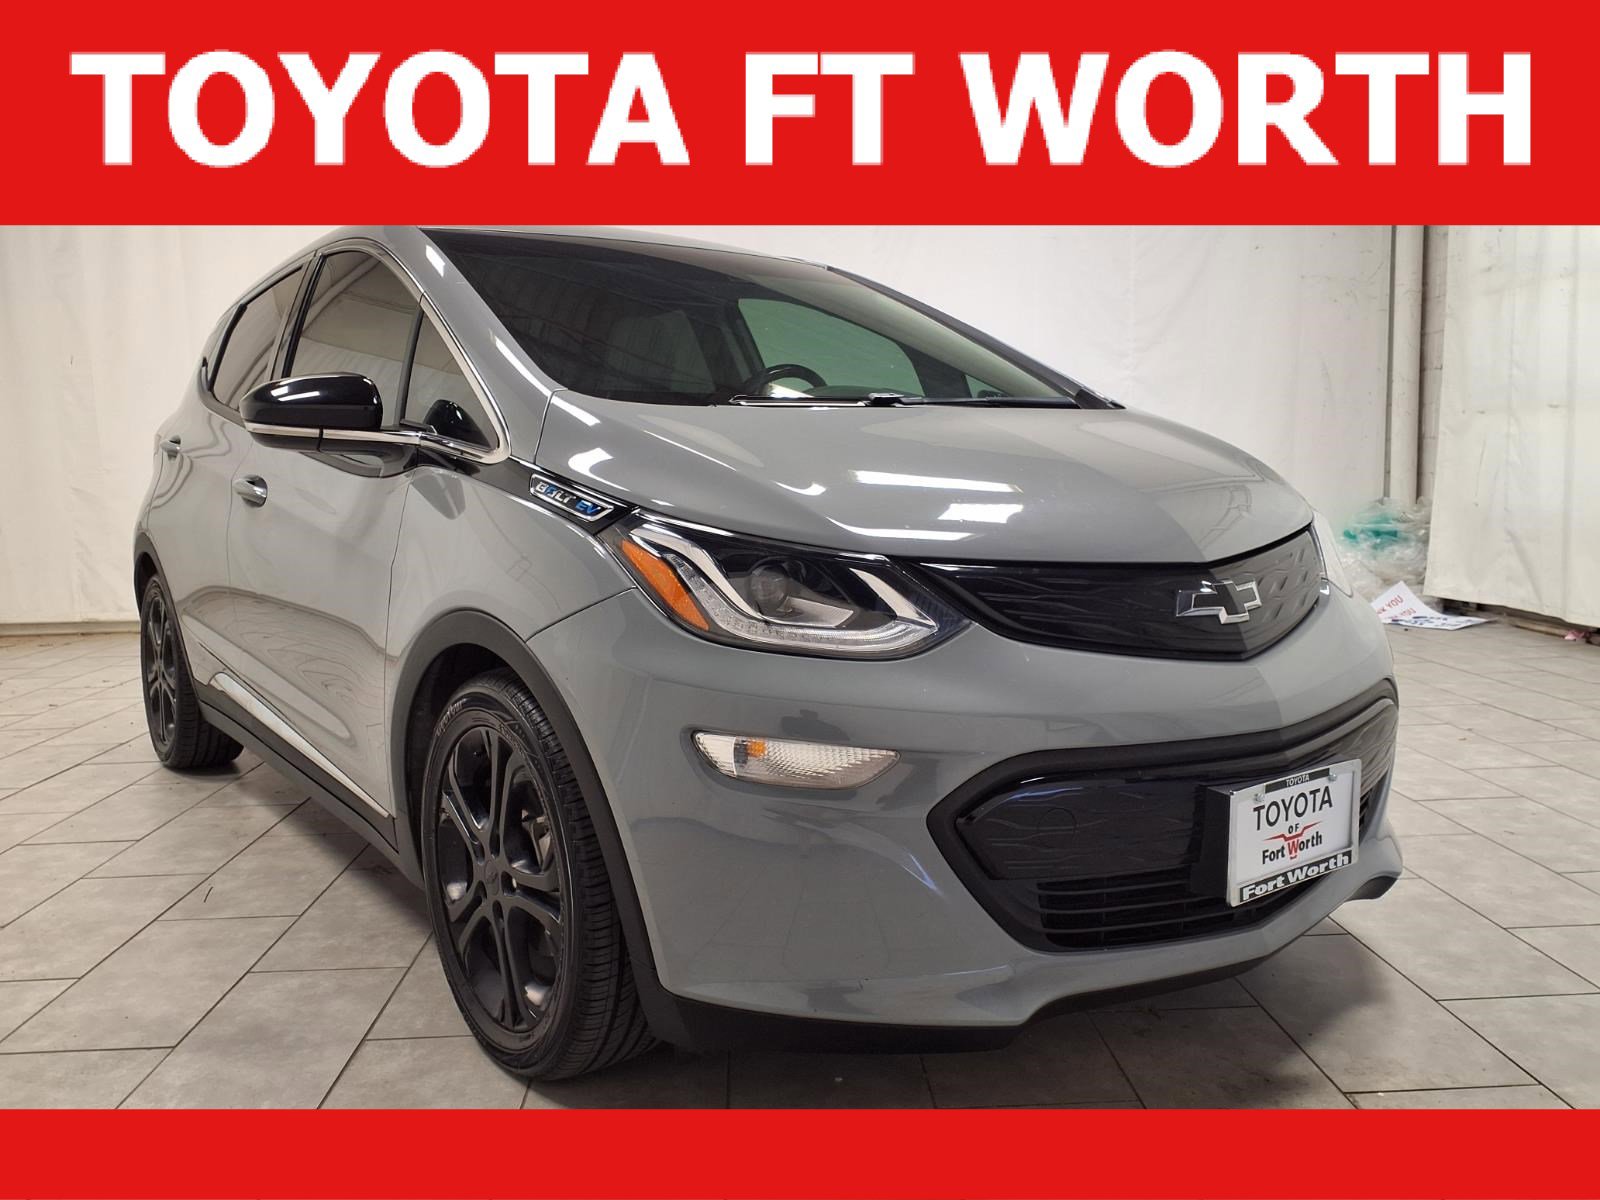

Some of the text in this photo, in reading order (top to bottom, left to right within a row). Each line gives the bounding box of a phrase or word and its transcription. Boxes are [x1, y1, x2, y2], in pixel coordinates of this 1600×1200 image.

[575, 500, 601, 514] EV
[1285, 774, 1310, 787] TOYOTA
[1252, 785, 1333, 831] TOYOTA
[1288, 823, 1300, 834] OF
[1262, 831, 1323, 865] Fort Worth
[1242, 853, 1350, 901] Fort Worth
